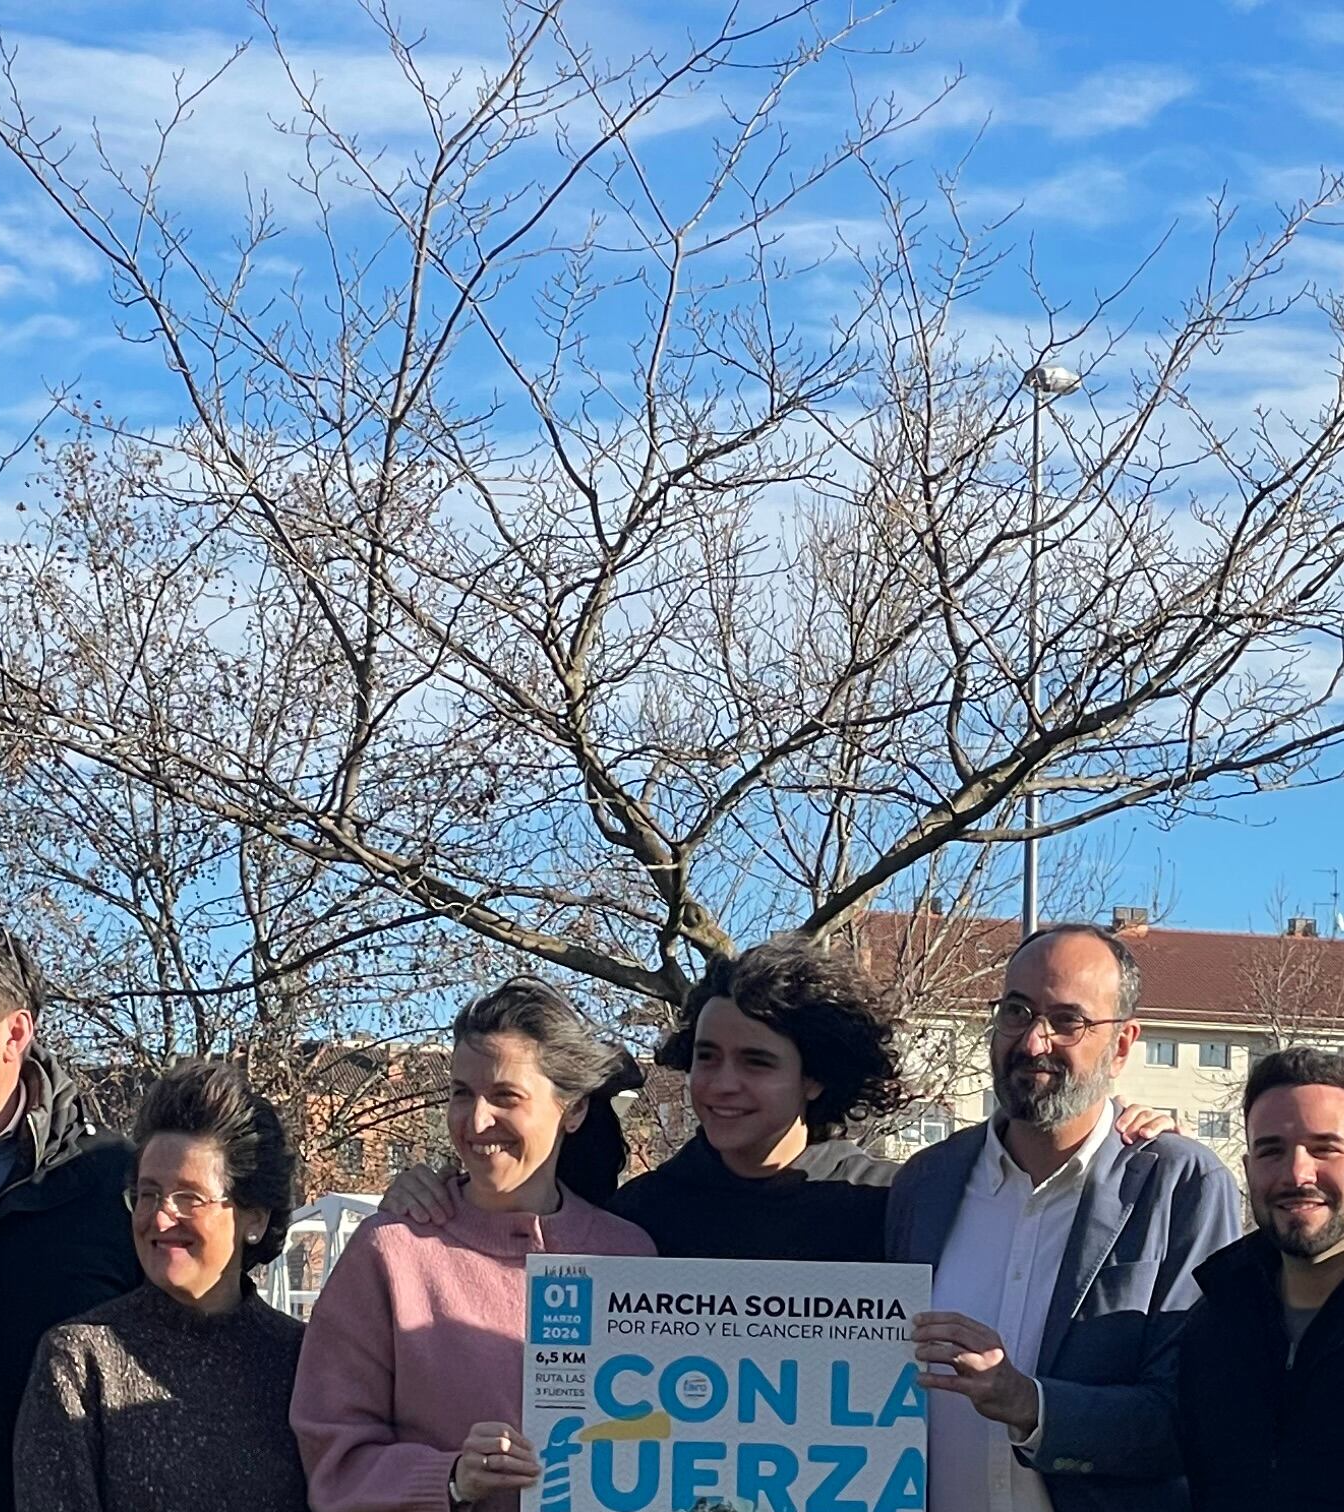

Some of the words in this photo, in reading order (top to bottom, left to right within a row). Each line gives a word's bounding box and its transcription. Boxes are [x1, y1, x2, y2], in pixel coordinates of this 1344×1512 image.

[544, 1284, 578, 1308] 01
[608, 1291, 738, 1316] MARCHA
[744, 1295, 906, 1320] SOLIDARIA
[543, 1315, 582, 1324] MARZO
[543, 1327, 580, 1339] 2026
[607, 1319, 645, 1334] POR
[651, 1321, 700, 1336] FARO
[705, 1322, 716, 1336] Y
[722, 1322, 741, 1337] EL
[746, 1323, 824, 1339] CANCER
[829, 1325, 912, 1341] INFANTIL
[536, 1352, 559, 1365] 6,5
[563, 1352, 586, 1364] KM
[536, 1373, 564, 1382] RUTA
[566, 1374, 586, 1383] LAS
[544, 1388, 585, 1396] FUENTES
[593, 1353, 797, 1425] CON
[830, 1360, 927, 1427] LA
